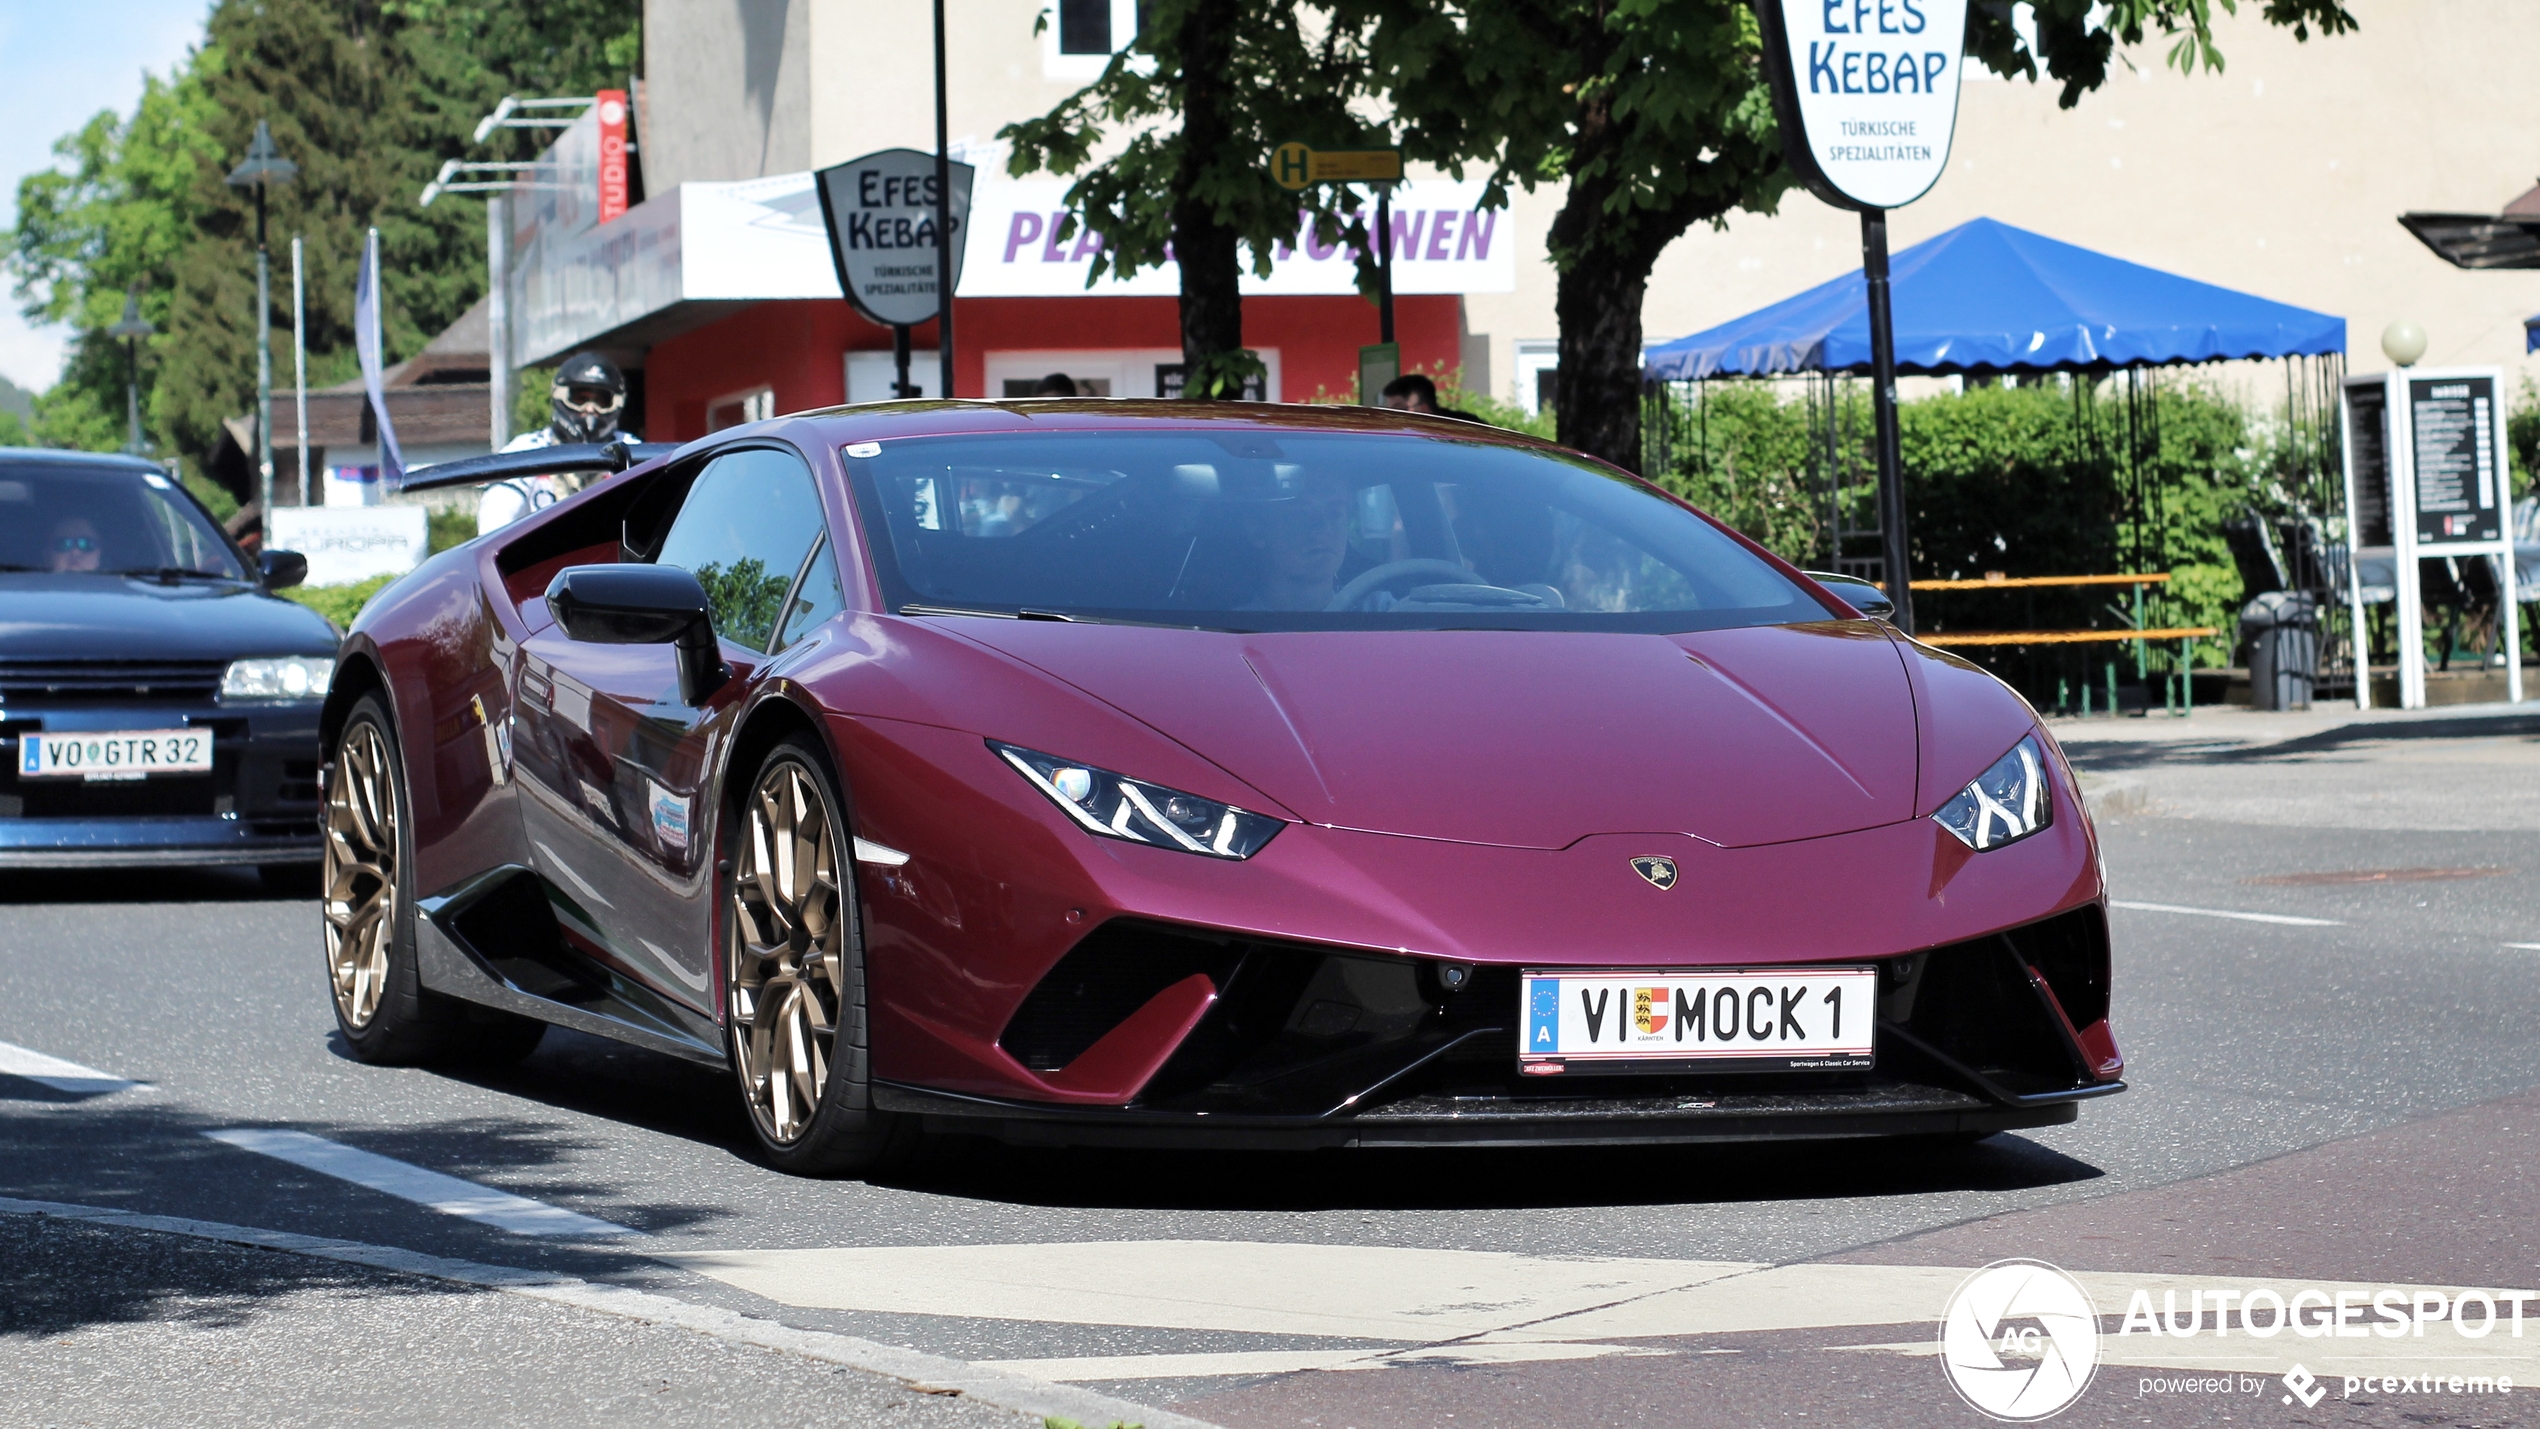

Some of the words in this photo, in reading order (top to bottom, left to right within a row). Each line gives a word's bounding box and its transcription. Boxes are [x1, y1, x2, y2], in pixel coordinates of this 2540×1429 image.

[1823, 0, 1926, 34] EFES
[1809, 41, 1947, 94] KEBAP
[1840, 117, 1917, 136] TÜRKISCHE
[1829, 142, 1932, 161] SPEZIALITÄTEN
[1281, 149, 1308, 182] H
[603, 136, 626, 223] TUDIO
[874, 264, 933, 277] TÜRKISCHE
[864, 281, 938, 295] SPEZIALITÄTE
[48, 741, 82, 766] VO
[105, 738, 157, 765] GTR
[165, 738, 199, 764] 32
[1581, 988, 1627, 1043] VI
[1675, 986, 1807, 1042] MOCK
[1824, 986, 1841, 1039] 1
[1537, 1025, 1551, 1043] A
[1637, 1034, 1664, 1042] KÄRNTEN
